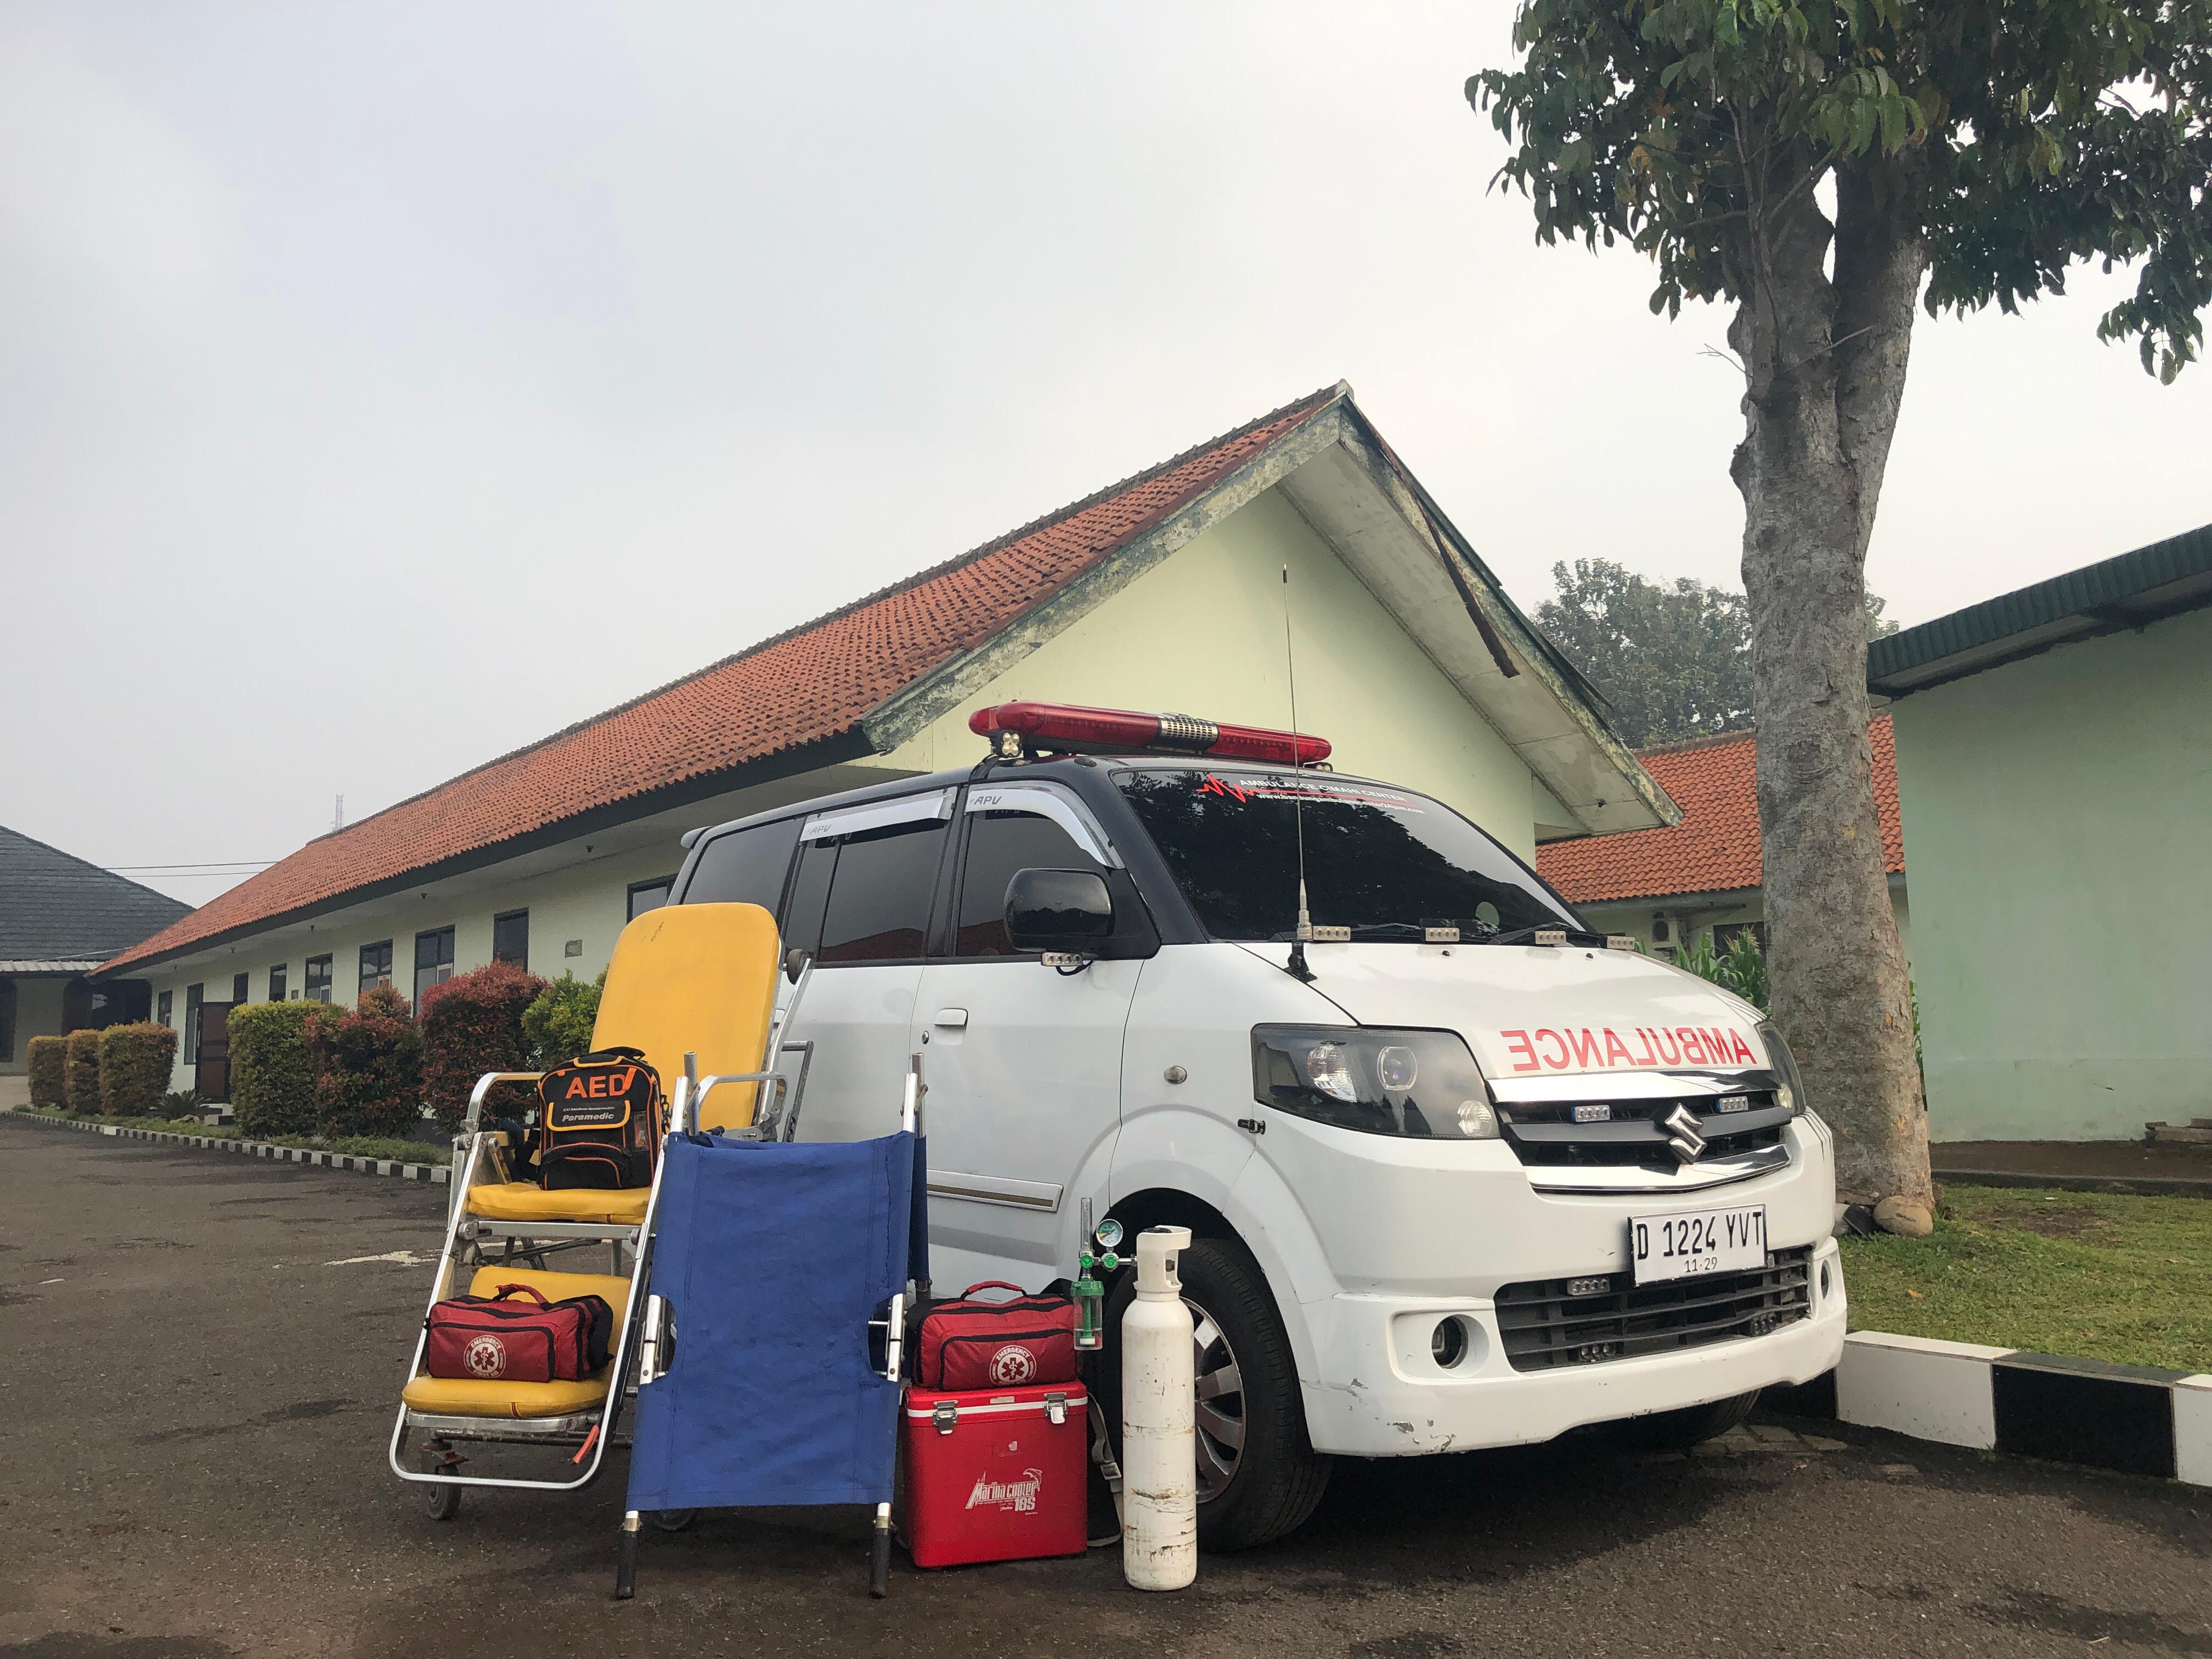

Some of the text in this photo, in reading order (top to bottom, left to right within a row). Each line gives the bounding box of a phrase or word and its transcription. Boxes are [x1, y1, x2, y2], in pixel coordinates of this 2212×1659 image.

[1240, 780, 1407, 802] AMBULANCE CIMAHI CENTER
[974, 796, 1002, 805] APV
[810, 824, 832, 834] APV
[565, 1074, 626, 1099] AED
[562, 1112, 614, 1122] Paramedic
[1637, 1211, 1762, 1260] D 1224 YVT
[471, 1337, 501, 1349] EMERGENCY
[996, 1347, 1030, 1361] EMERGENCY
